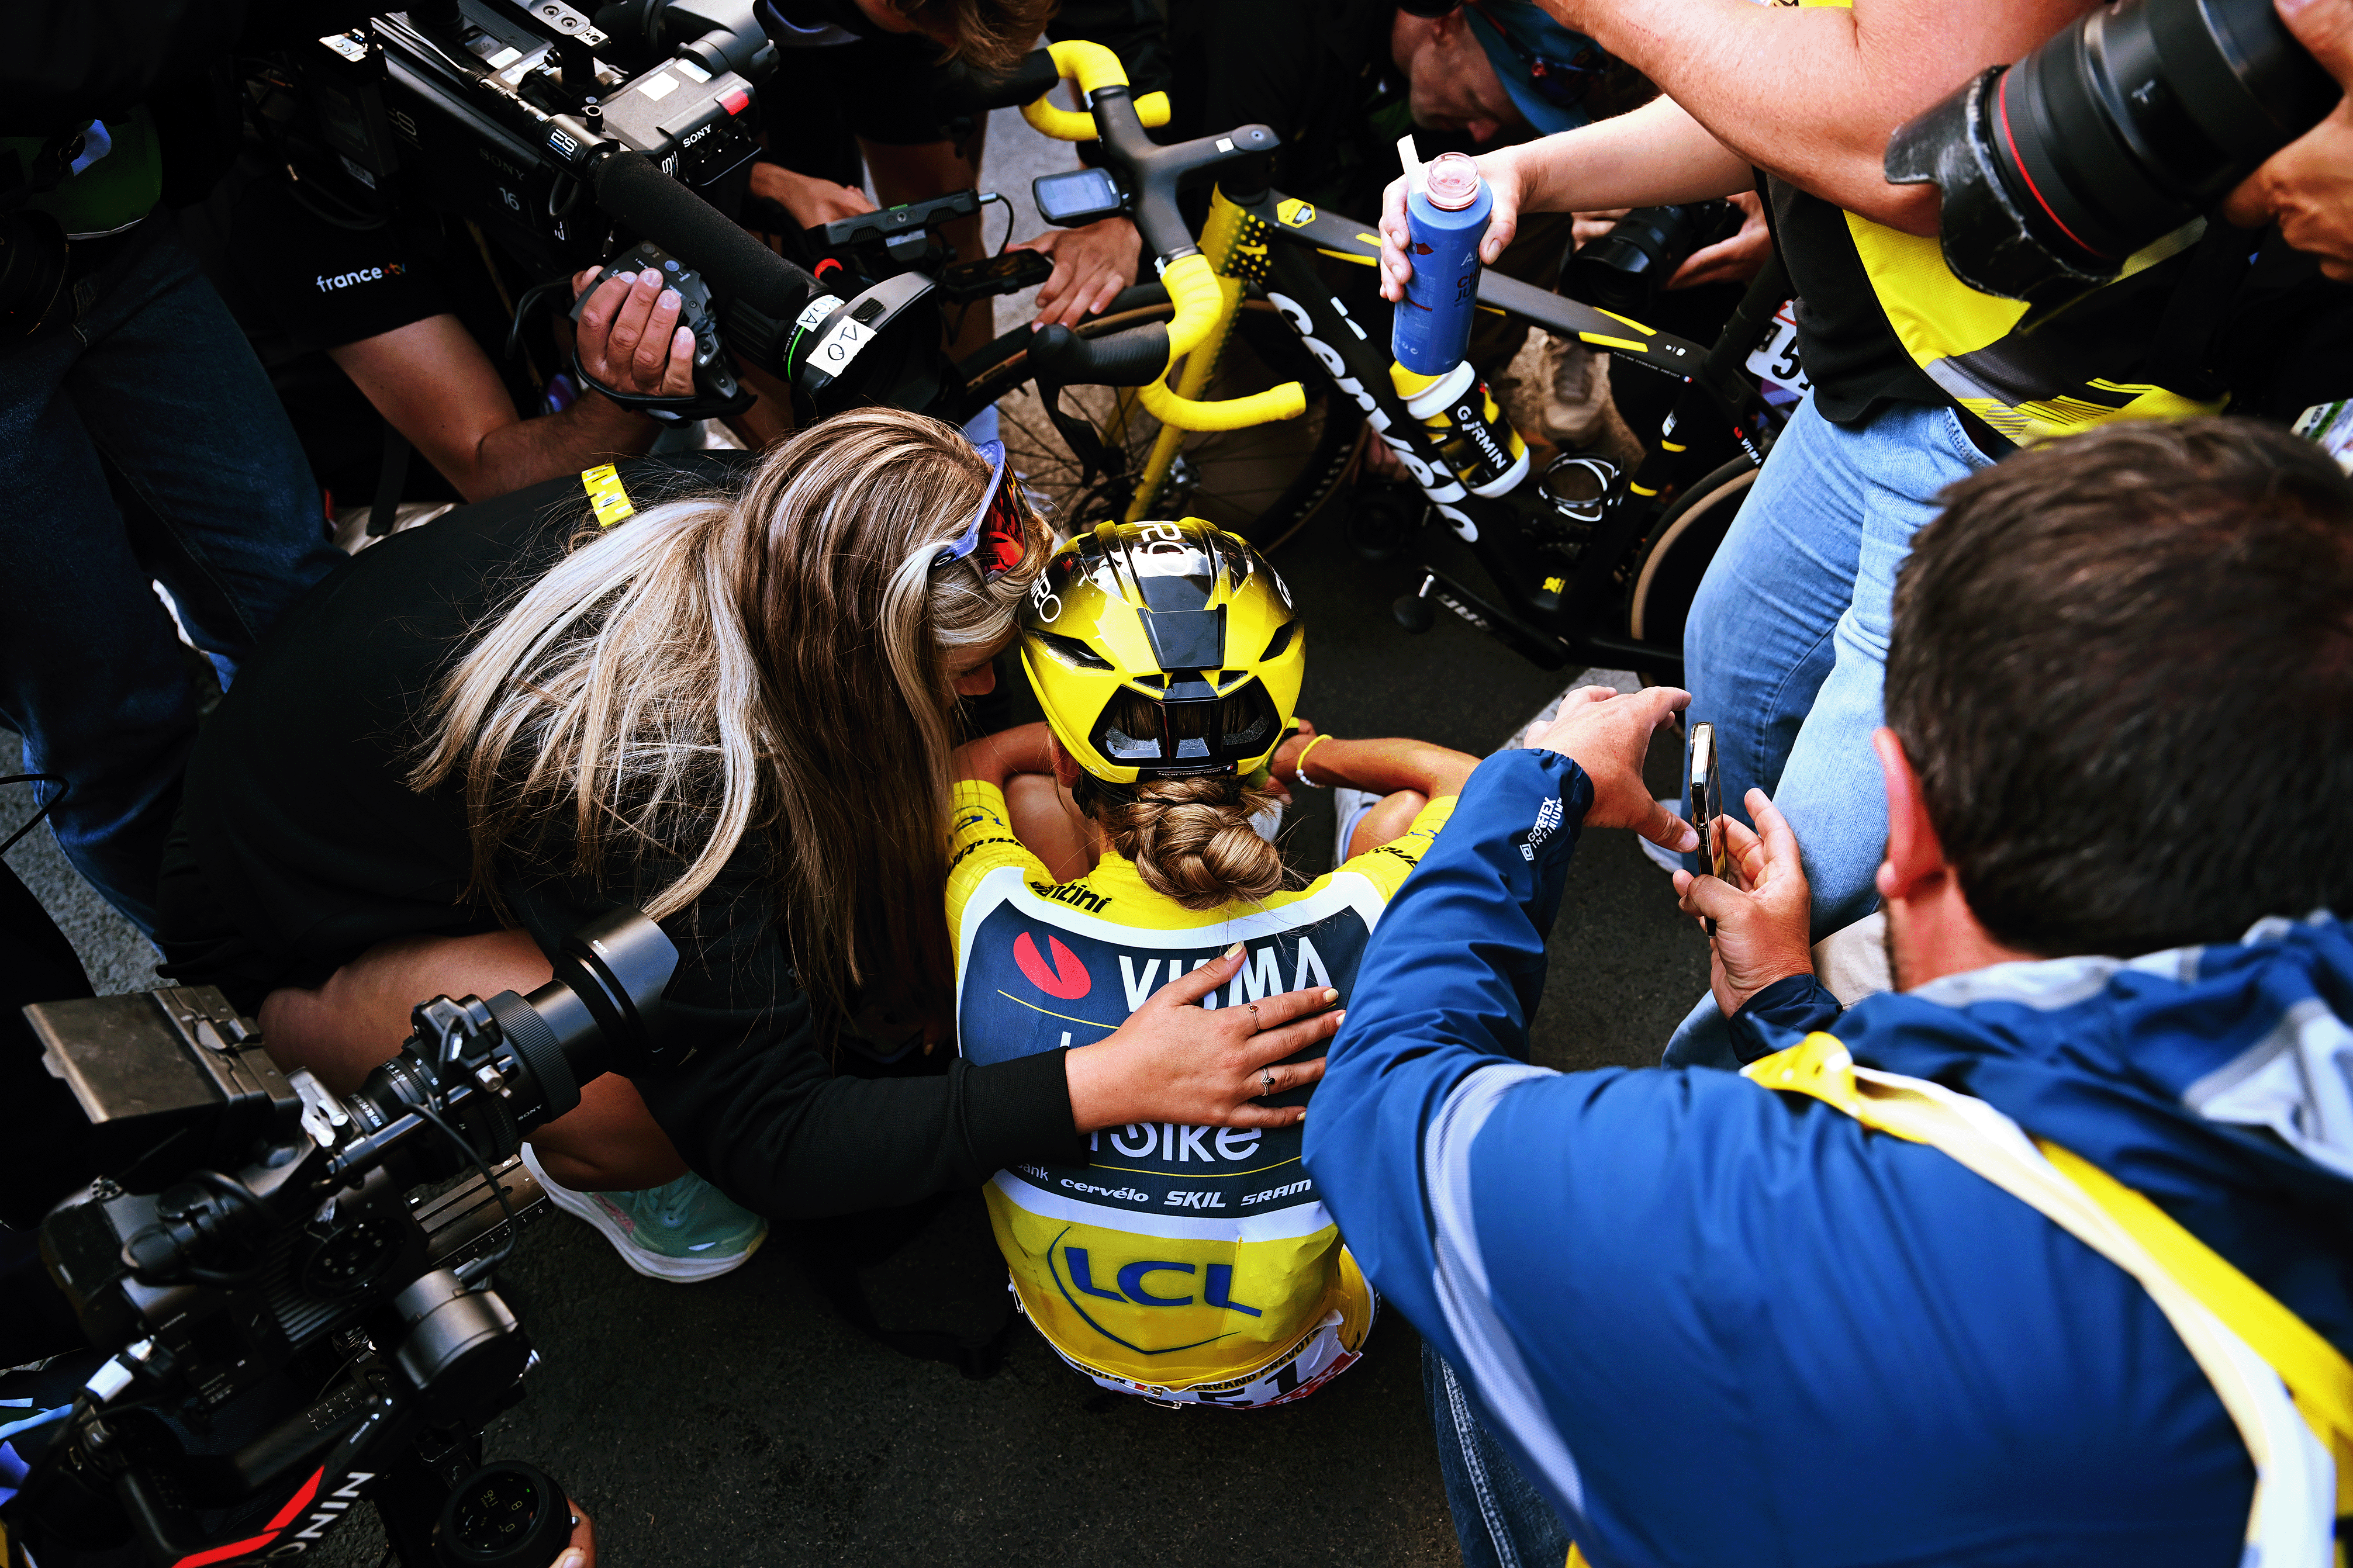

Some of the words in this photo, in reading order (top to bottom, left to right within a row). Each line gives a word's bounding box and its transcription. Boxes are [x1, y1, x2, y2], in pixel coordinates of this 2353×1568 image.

[551, 128, 578, 153] ES
[683, 123, 711, 148] SONY
[479, 148, 525, 181] SONY
[499, 187, 520, 211] 16
[1267, 292, 1479, 543] cervélo
[517, 1103, 543, 1121] SONY
[1060, 1178, 1149, 1202] cervélo
[1163, 1190, 1226, 1209] SKIL
[1240, 1179, 1311, 1206] SRAM
[1064, 1247, 1262, 1317] LCL
[266, 1472, 376, 1559] ONIN
